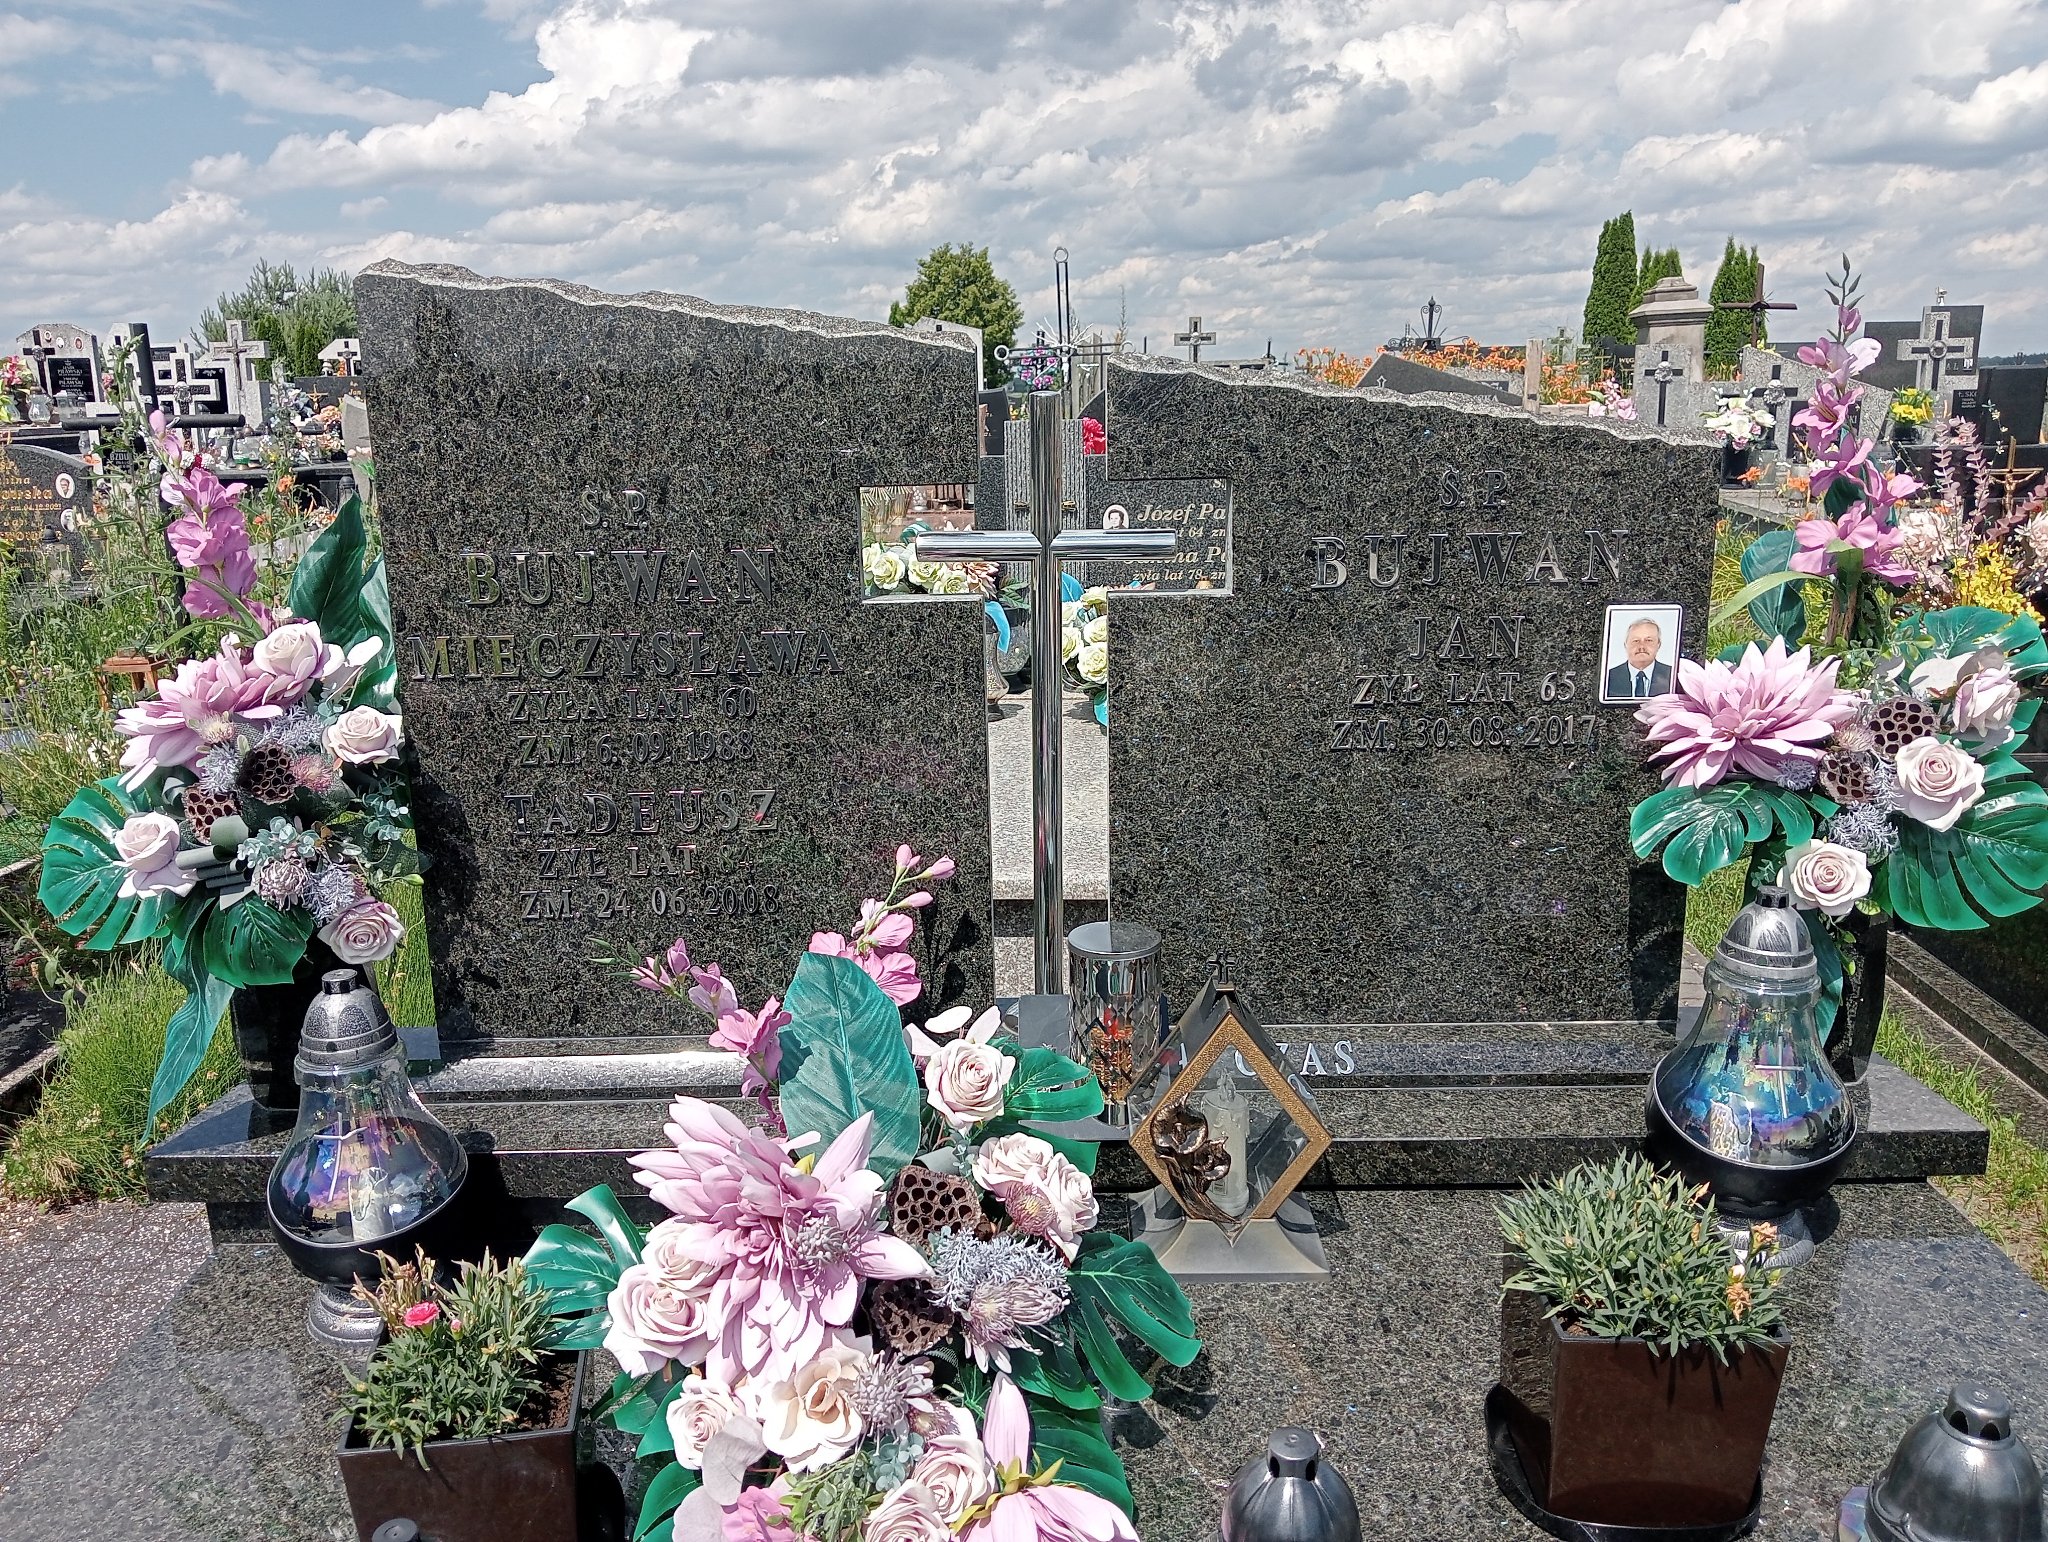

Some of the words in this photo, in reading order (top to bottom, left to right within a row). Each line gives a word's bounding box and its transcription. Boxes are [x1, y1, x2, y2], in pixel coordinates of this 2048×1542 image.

[1137, 503, 1196, 525] Józef
[1188, 527, 1204, 538] 64
[1163, 568, 1184, 581] lat
[1310, 529, 1629, 590] BUJWAN
[460, 549, 775, 605] BUJWAN
[1410, 615, 1526, 660] JAN
[406, 629, 844, 680] MIECZYSŁAWA
[625, 687, 695, 720] LAT
[720, 686, 757, 718] 60
[1446, 672, 1520, 704] LAT
[1540, 671, 1577, 701] 65
[686, 730, 754, 762] 1988
[1524, 714, 1596, 747] 2017
[504, 788, 779, 836] TADEUSZ
[627, 843, 697, 877] LAT
[703, 884, 779, 916] 2008
